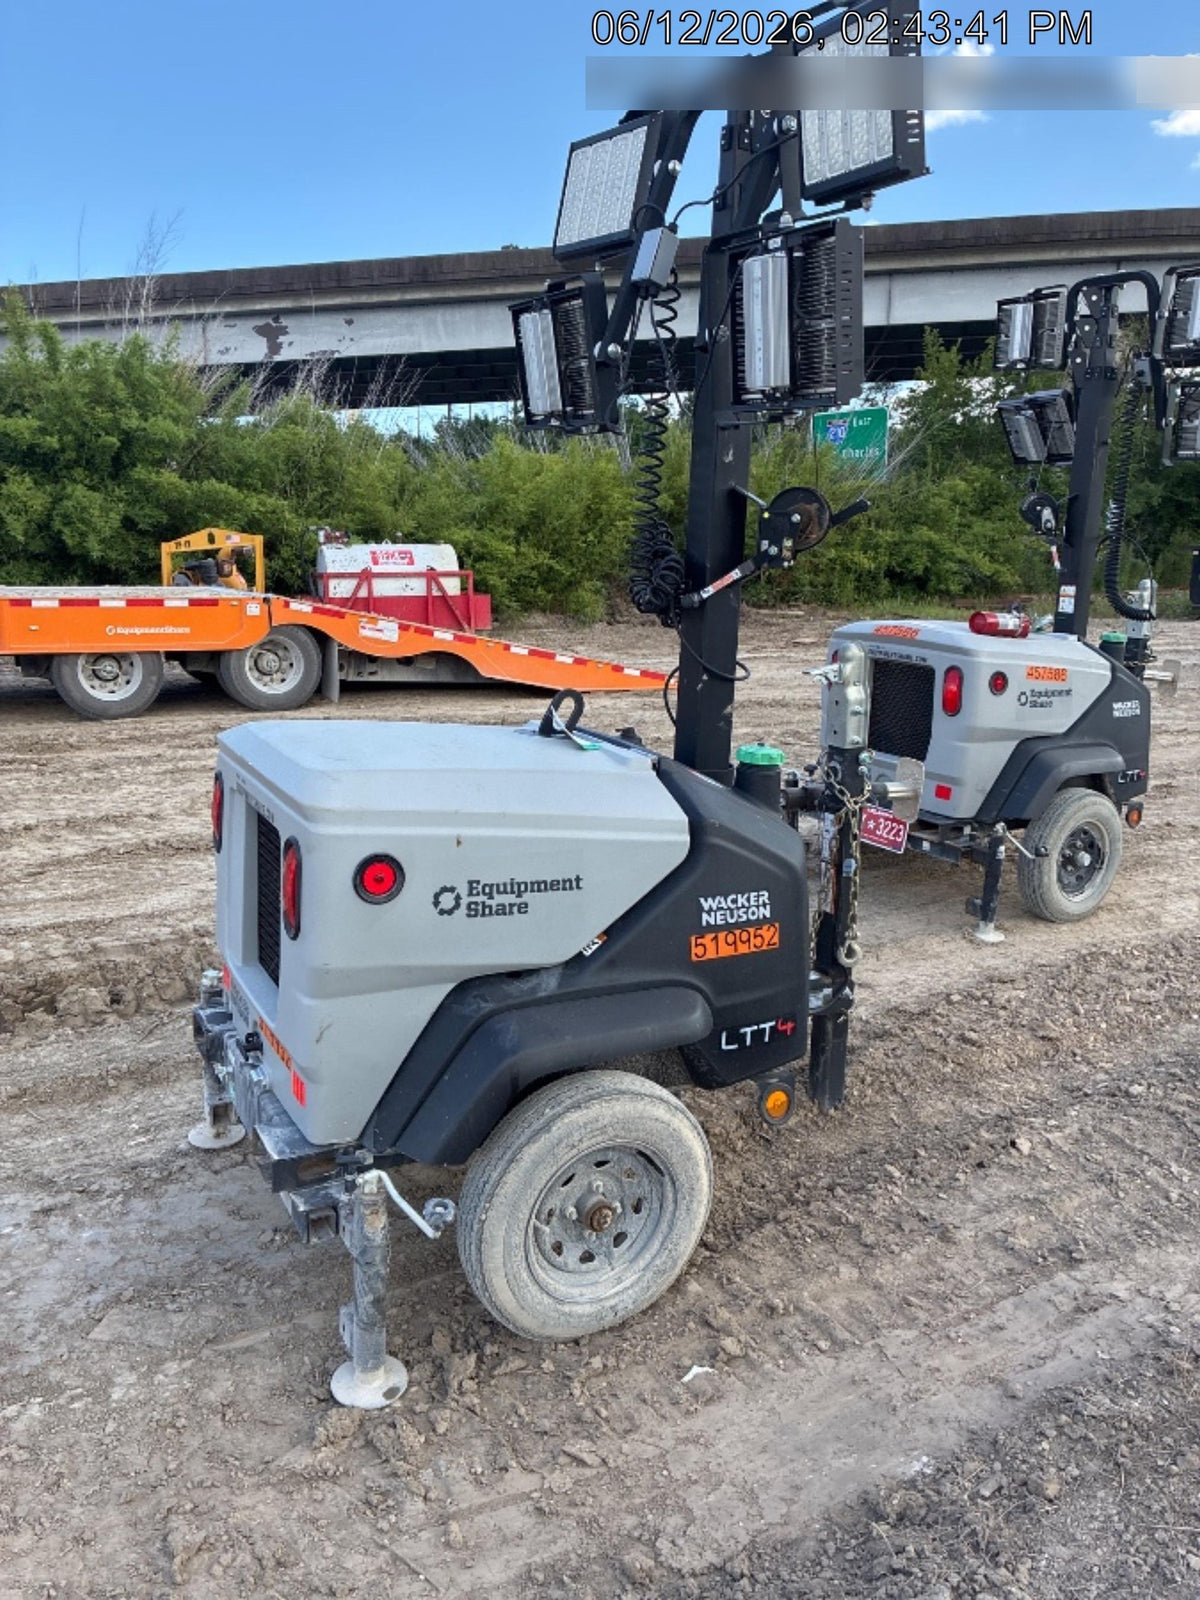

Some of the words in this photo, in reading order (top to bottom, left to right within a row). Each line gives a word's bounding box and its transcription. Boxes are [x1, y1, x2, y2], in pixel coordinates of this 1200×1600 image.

[466, 874, 584, 900] Equipment
[465, 901, 529, 918] Share
[699, 890, 771, 912] WACKER
[701, 905, 771, 927] NEUSON
[693, 923, 779, 960] 519952
[720, 1017, 797, 1051] LTT4
